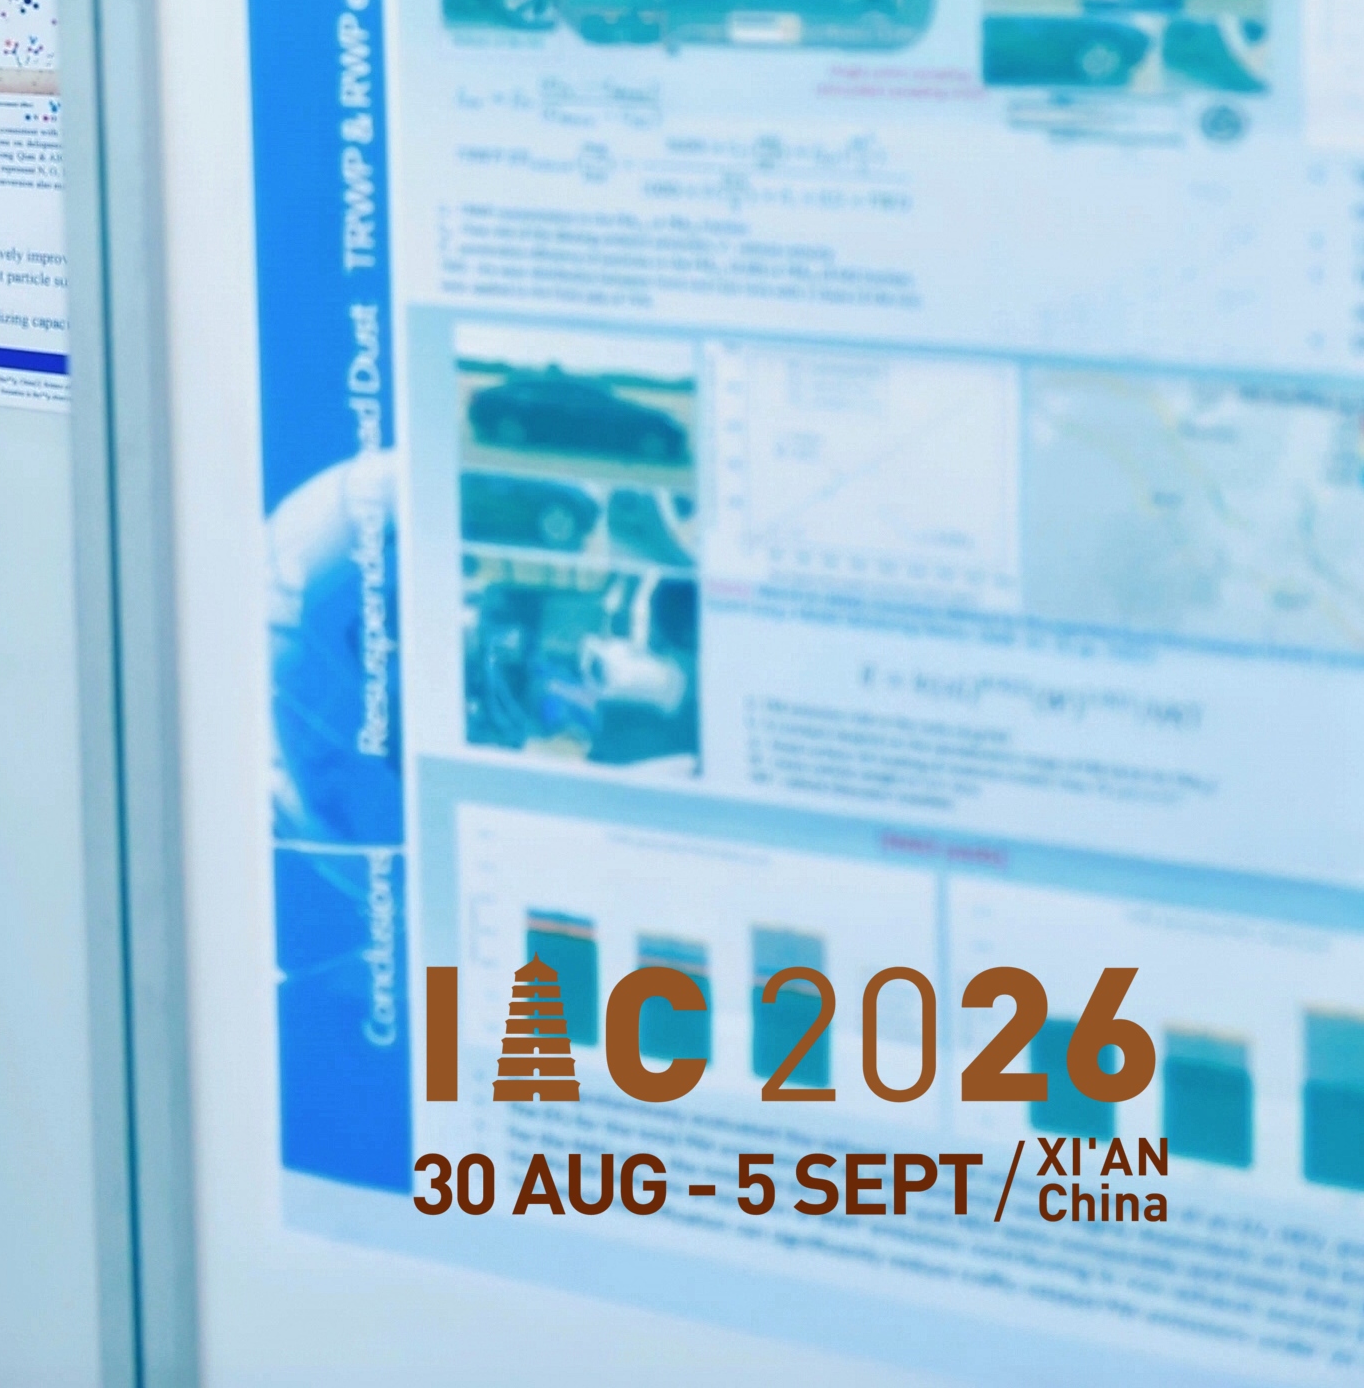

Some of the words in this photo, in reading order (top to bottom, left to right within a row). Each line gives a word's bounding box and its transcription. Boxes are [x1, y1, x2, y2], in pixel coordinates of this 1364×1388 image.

[338, 13, 374, 109] RWP
[341, 115, 374, 144] &
[342, 147, 376, 273] TRWP
[348, 303, 382, 395] Dust
[363, 848, 397, 1047] Conclusions
